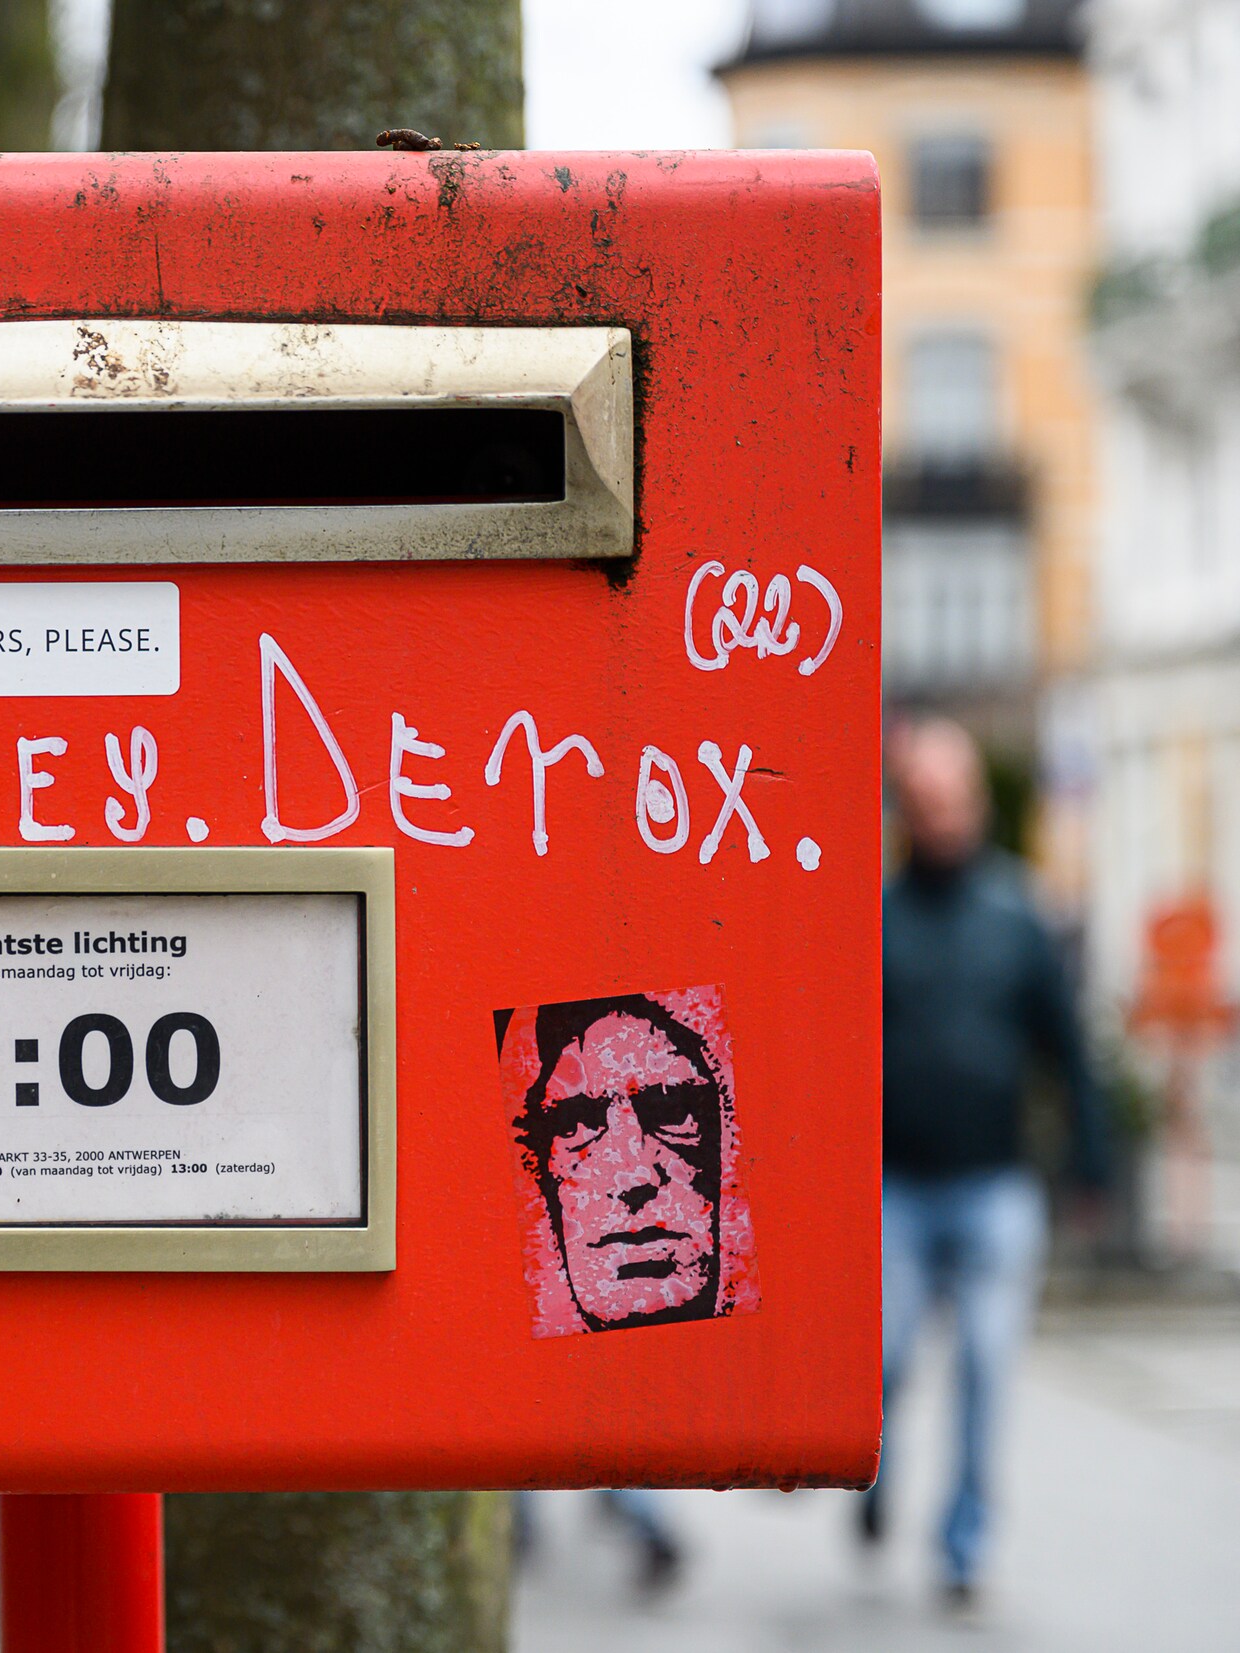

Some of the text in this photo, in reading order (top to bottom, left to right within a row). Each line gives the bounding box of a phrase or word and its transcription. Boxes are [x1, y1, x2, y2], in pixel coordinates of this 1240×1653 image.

[684, 560, 843, 676] (22)
[45, 628, 160, 653] PLEASE.
[73, 931, 188, 959] lichting
[1, 965, 76, 982] maandag
[81, 965, 105, 979] tot
[109, 963, 172, 981] vrijdag:
[32, 1152, 71, 1165] 33-35,
[75, 1151, 105, 1162] 2000
[107, 1150, 181, 1161] ANTWERPEN
[10, 1165, 36, 1178] (van
[40, 1164, 93, 1178] maandag
[96, 1164, 113, 1175] tot
[117, 1163, 163, 1178] vrijdag)
[171, 1163, 207, 1174] 13:00
[215, 1162, 276, 1176] (zaterdag)
